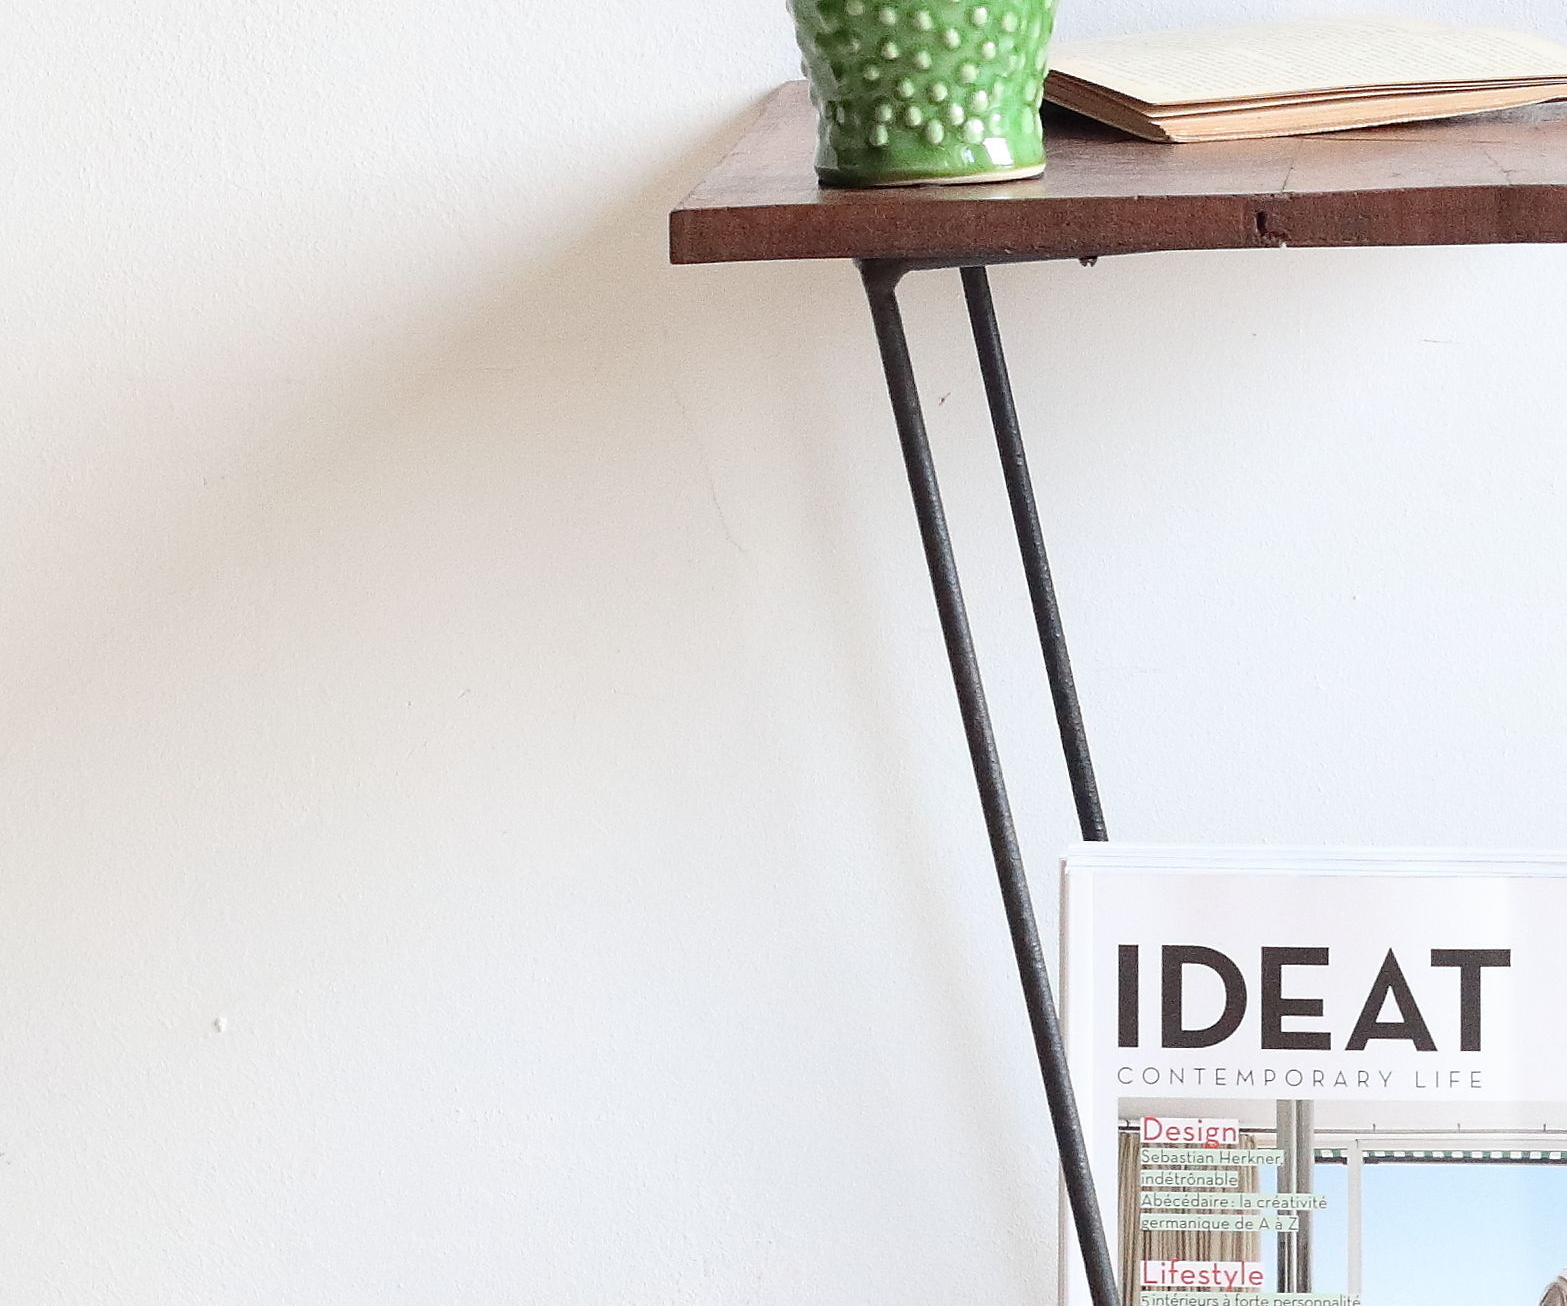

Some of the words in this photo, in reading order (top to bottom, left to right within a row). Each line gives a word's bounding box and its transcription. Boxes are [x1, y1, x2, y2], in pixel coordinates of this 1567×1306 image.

[1117, 944, 1511, 1052] IDEAT
[1116, 1066, 1393, 1089] CONTEMPORARY
[1415, 1070, 1483, 1089] LIFE
[1142, 1115, 1237, 1149] Design
[1141, 1151, 1214, 1164] Sebastian
[1219, 1151, 1284, 1166] Herkner,
[1141, 1172, 1239, 1186] indétrônable
[1240, 1194, 1251, 1208] la
[1256, 1194, 1328, 1209] créativité
[1141, 1217, 1230, 1231] germanique
[1235, 1216, 1253, 1230] de
[1258, 1217, 1271, 1230] A
[1275, 1216, 1283, 1230] à
[1288, 1217, 1299, 1230] Z
[1143, 1258, 1265, 1291] Lifestyle
[1152, 1294, 1219, 1306] intérieurs
